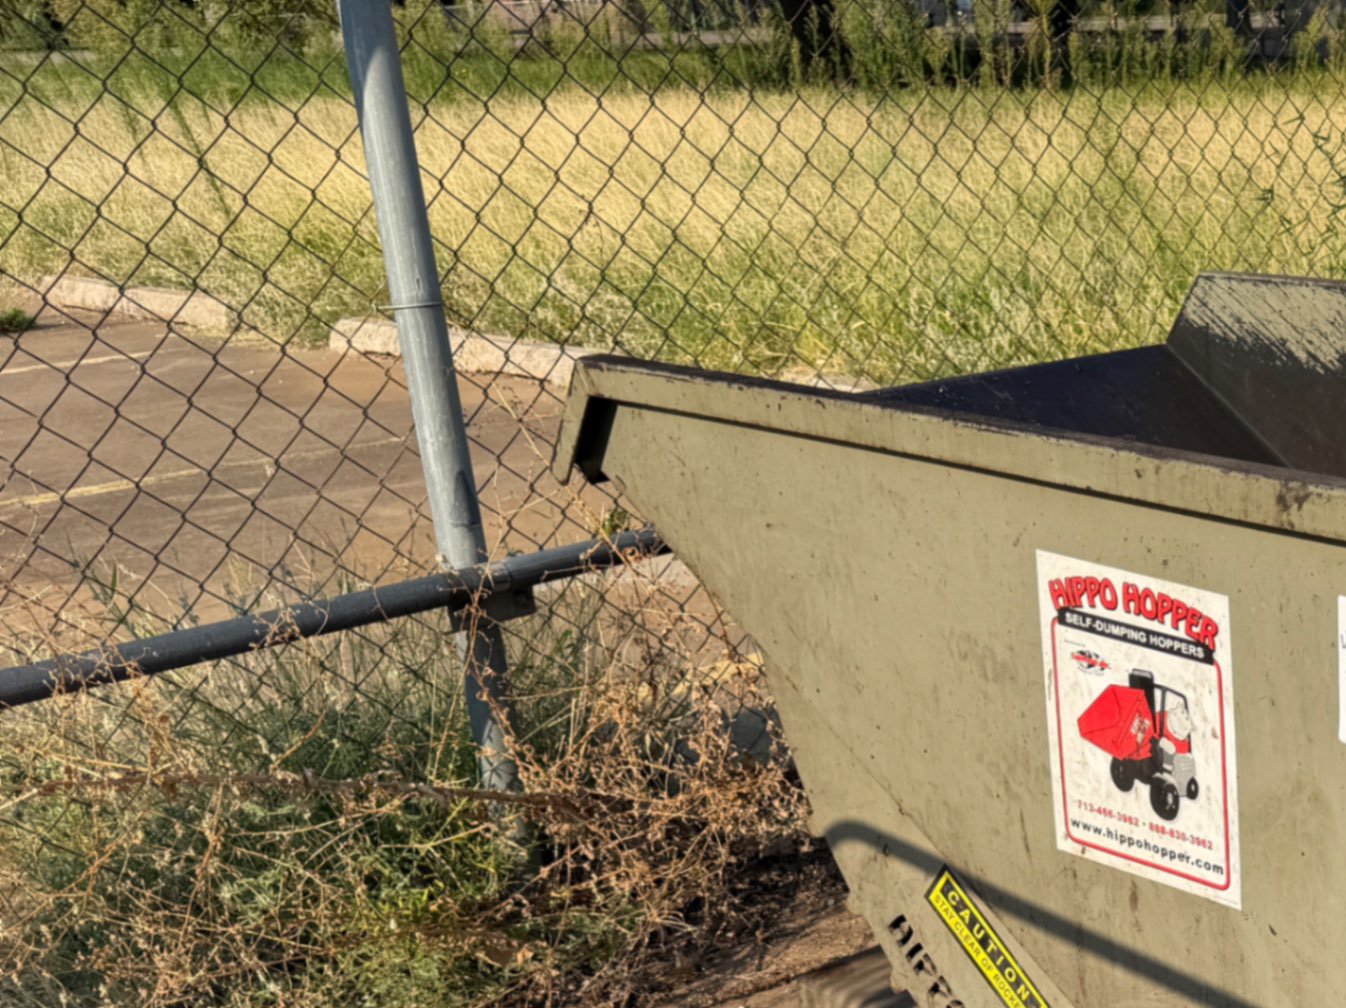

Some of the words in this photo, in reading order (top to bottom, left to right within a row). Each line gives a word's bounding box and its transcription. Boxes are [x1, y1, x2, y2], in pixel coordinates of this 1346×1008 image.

[1048, 576, 1118, 611] HIPPO
[1121, 581, 1219, 651] HOPPER
[1065, 612, 1147, 643] SELF-DUMPING
[1149, 634, 1205, 659] HOPPERS
[1070, 818, 1224, 875] www.hippohopper.com
[934, 894, 955, 920] STAY
[954, 922, 982, 956] CLEAR
[980, 956, 994, 973] OF
[948, 891, 1031, 1002] CAUTION
